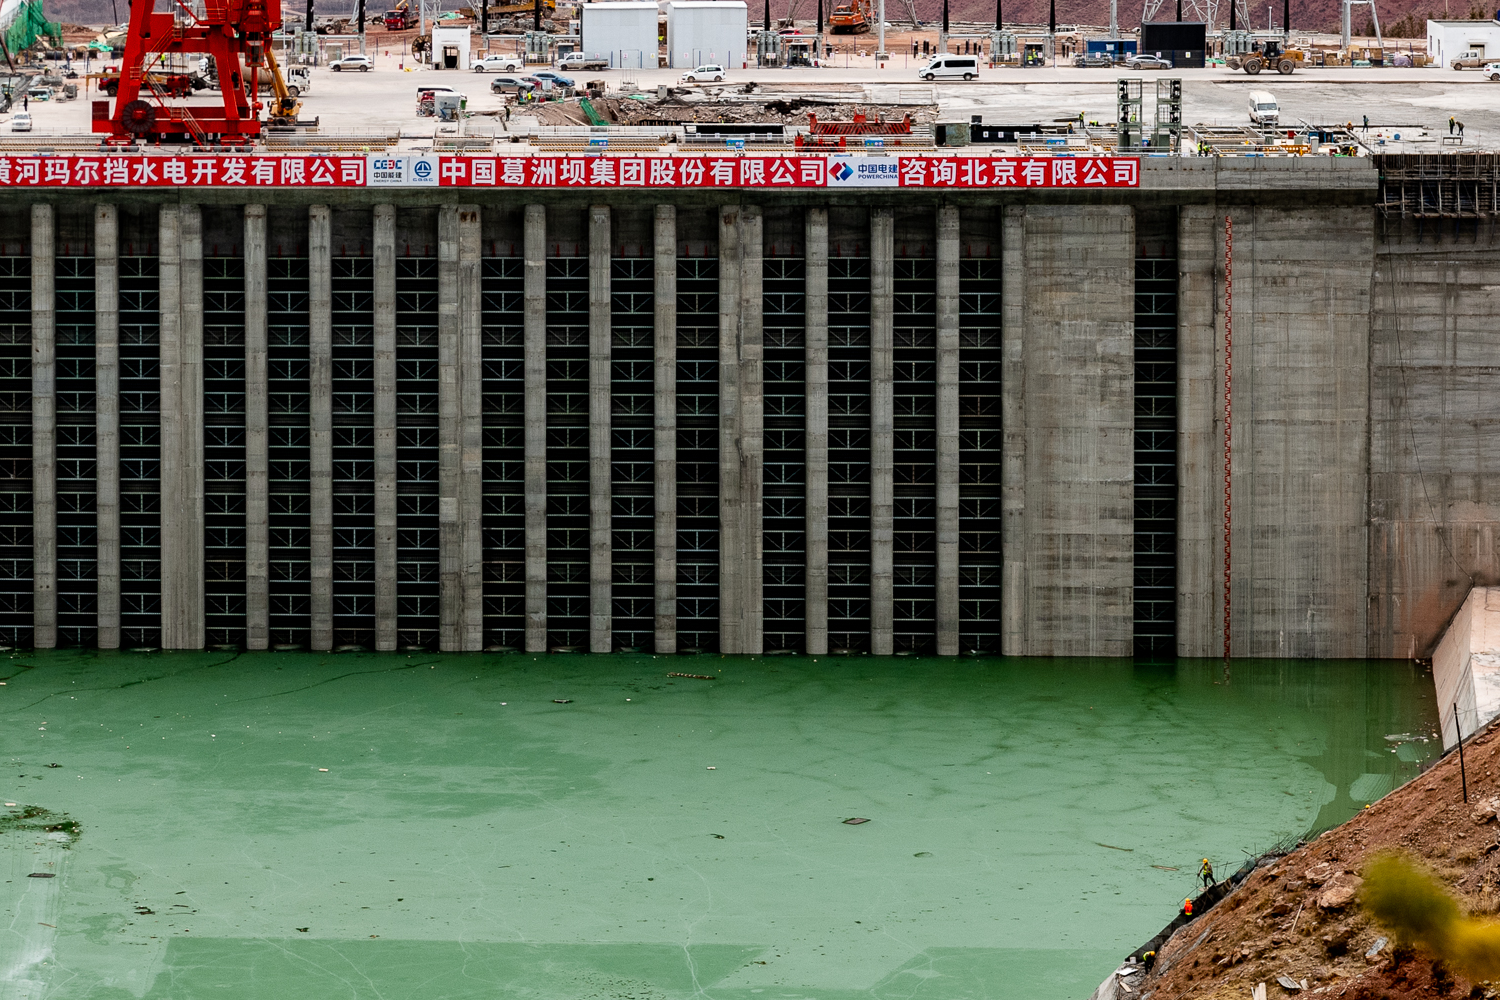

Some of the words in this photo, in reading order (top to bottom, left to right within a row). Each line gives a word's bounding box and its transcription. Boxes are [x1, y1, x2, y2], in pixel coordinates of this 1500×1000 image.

[442, 159, 824, 186] 中国葛洲坝集团股份有限公司
[858, 164, 898, 174] 中国电建
[901, 159, 1137, 185] 咨询北京有限公司
